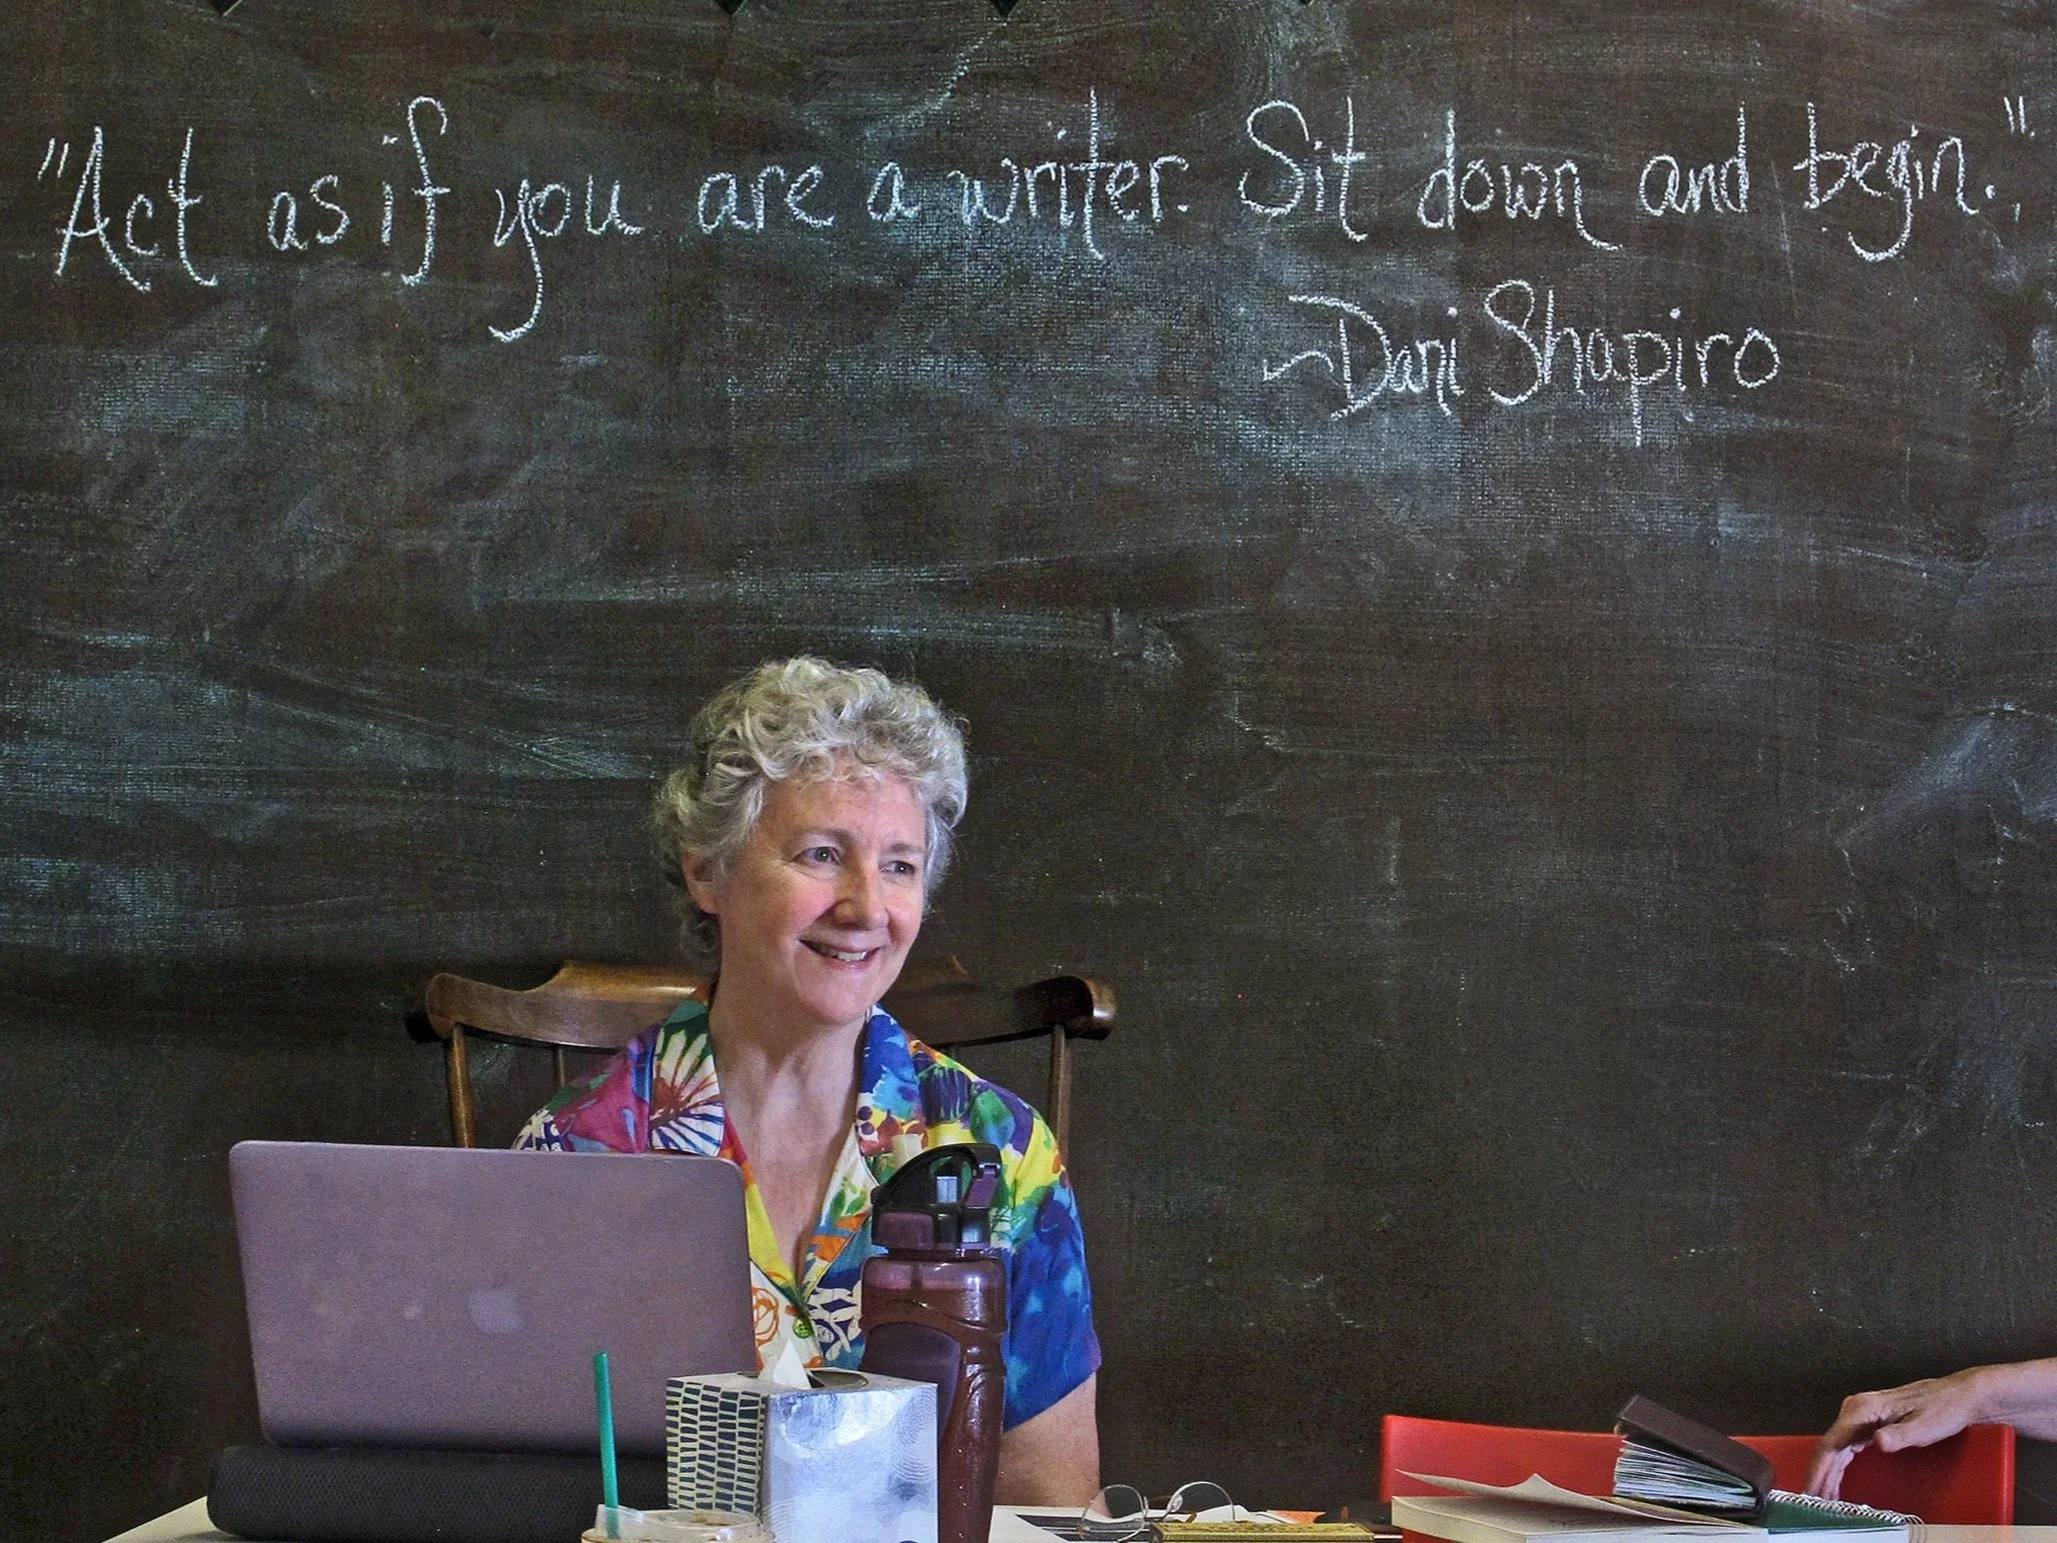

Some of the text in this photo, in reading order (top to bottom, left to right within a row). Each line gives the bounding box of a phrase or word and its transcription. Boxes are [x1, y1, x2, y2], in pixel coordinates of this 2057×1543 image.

[267, 175, 349, 251] as
[381, 96, 451, 287] if
[488, 178, 646, 343] you
[697, 164, 835, 235] are
[866, 160, 922, 223] a
[946, 86, 1190, 261] writer.
[1239, 99, 1367, 242] Sit
[1416, 107, 1622, 252] down
[1639, 101, 1750, 217] and
[1484, 279, 1781, 448] Shapiro
